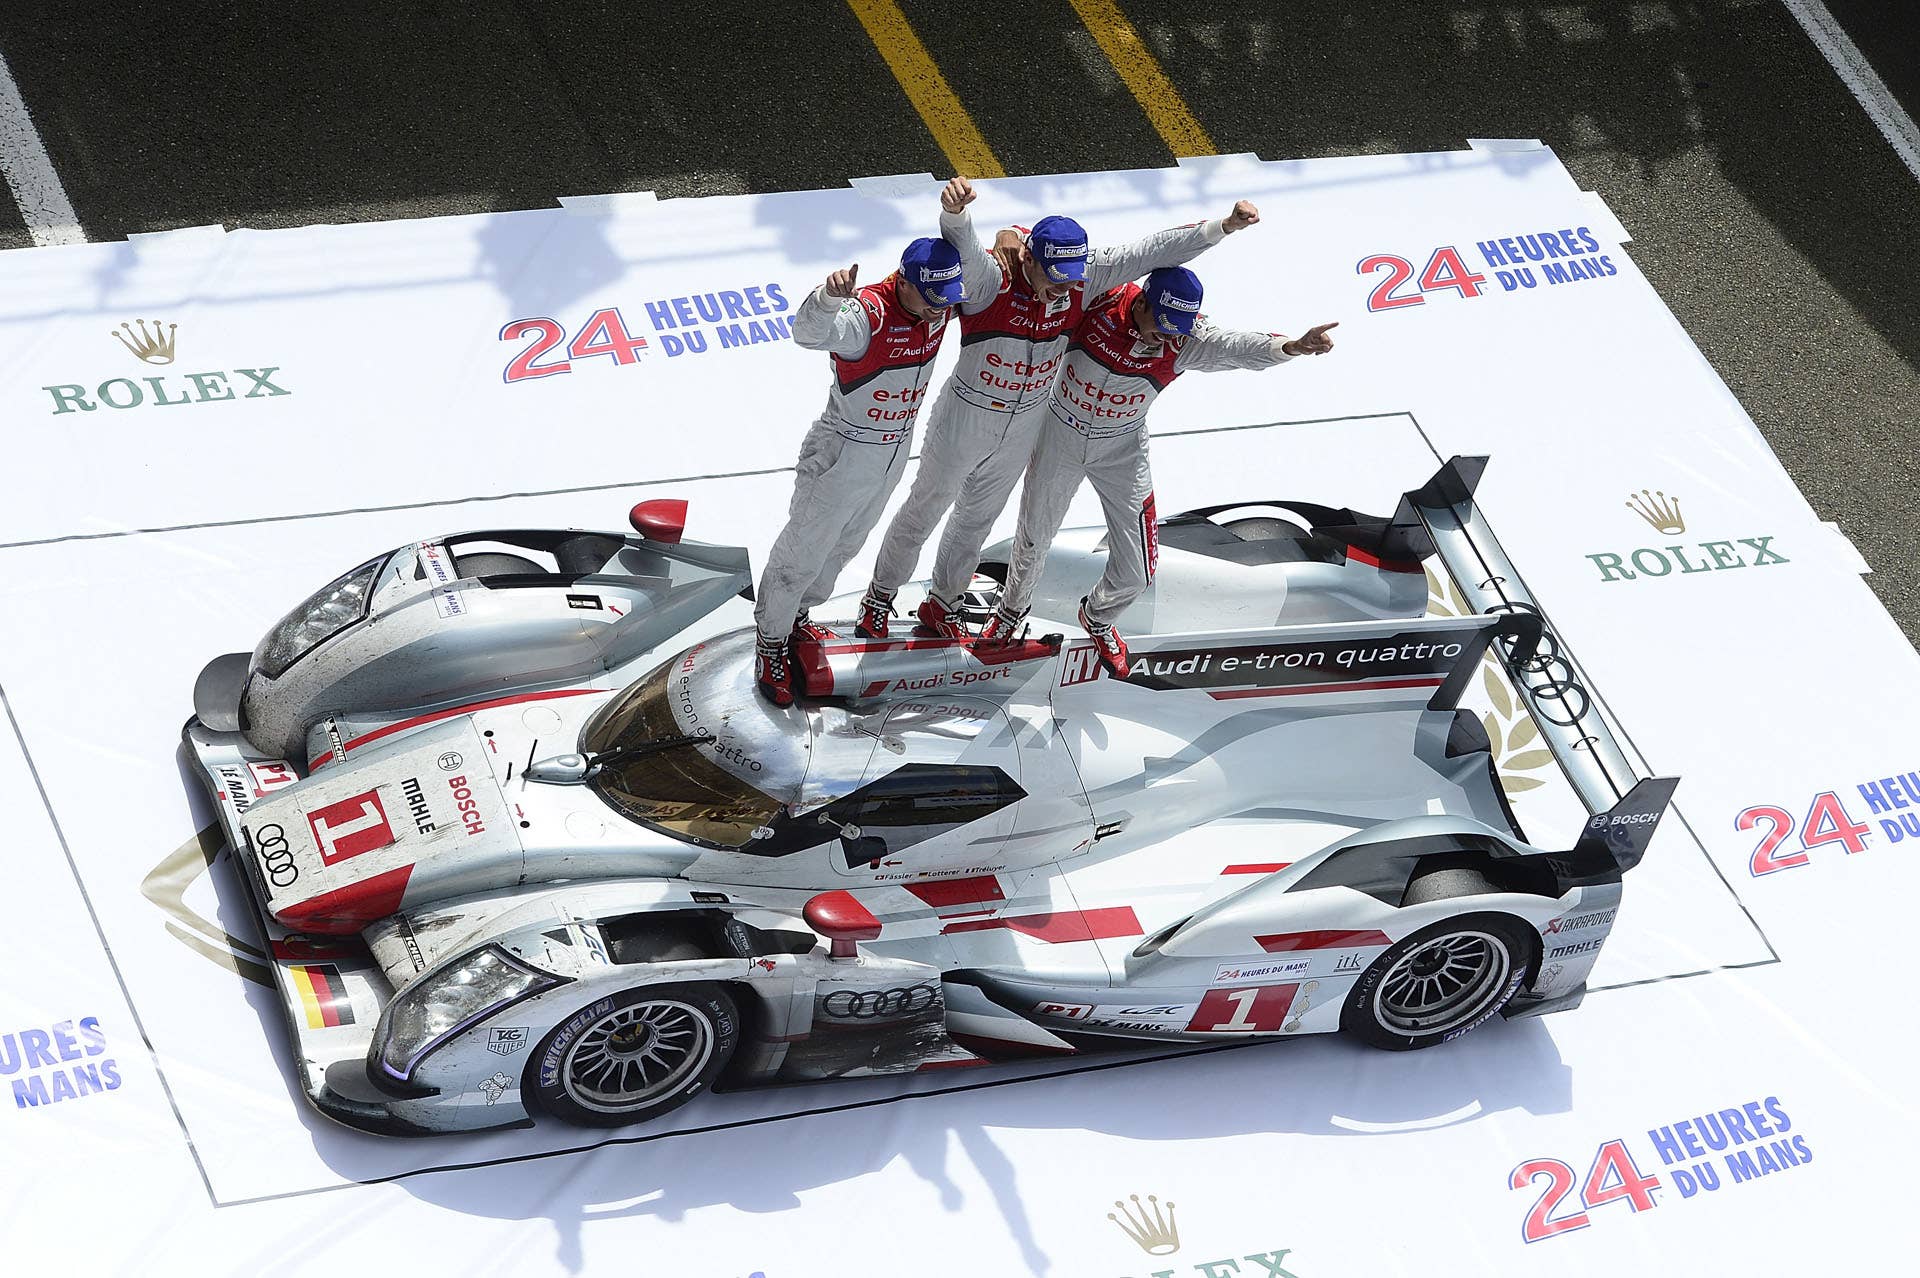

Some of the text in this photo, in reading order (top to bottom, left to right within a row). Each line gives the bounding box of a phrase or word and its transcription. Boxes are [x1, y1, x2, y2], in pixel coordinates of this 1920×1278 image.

[1476, 227, 1600, 268] HEURES
[1356, 245, 1486, 313] 24
[1495, 255, 1618, 292] DU MANS
[644, 283, 790, 331] HEURES
[499, 307, 649, 384] 24
[659, 334, 707, 357] DU
[1098, 342, 1152, 369] Audi Sport
[42, 367, 291, 414] ROLEX
[1061, 380, 1139, 419] quattro
[1067, 363, 1146, 405] e-tron
[1586, 535, 1790, 582] ROLEX
[892, 666, 1011, 692] Audi Sport
[1128, 640, 1462, 678] Audi e-tron quattro
[680, 676, 698, 724] e-tron
[696, 726, 762, 772] quattro
[256, 763, 292, 784] P1
[1857, 771, 1920, 815] HEU
[401, 777, 436, 836] MAHLE
[448, 774, 485, 837] BOSCH
[1611, 812, 1660, 826] BOSCH
[313, 800, 385, 858] 1
[1735, 791, 1872, 878] 24
[1336, 952, 1365, 969] itk
[1550, 938, 1602, 959] MAHLE
[1216, 962, 1309, 981] 24 HEURES DU MANS
[1043, 1004, 1083, 1018] P1
[1211, 988, 1260, 1031] 1
[489, 1041, 524, 1054] HEUER
[496, 1029, 522, 1041] TAG
[544, 998, 611, 1069] MICHELIN
[11, 1059, 122, 1109] MANS
[1648, 1096, 1792, 1166] HEURES
[1670, 1134, 1813, 1199] DU MANS
[1508, 1138, 1662, 1244] 24
